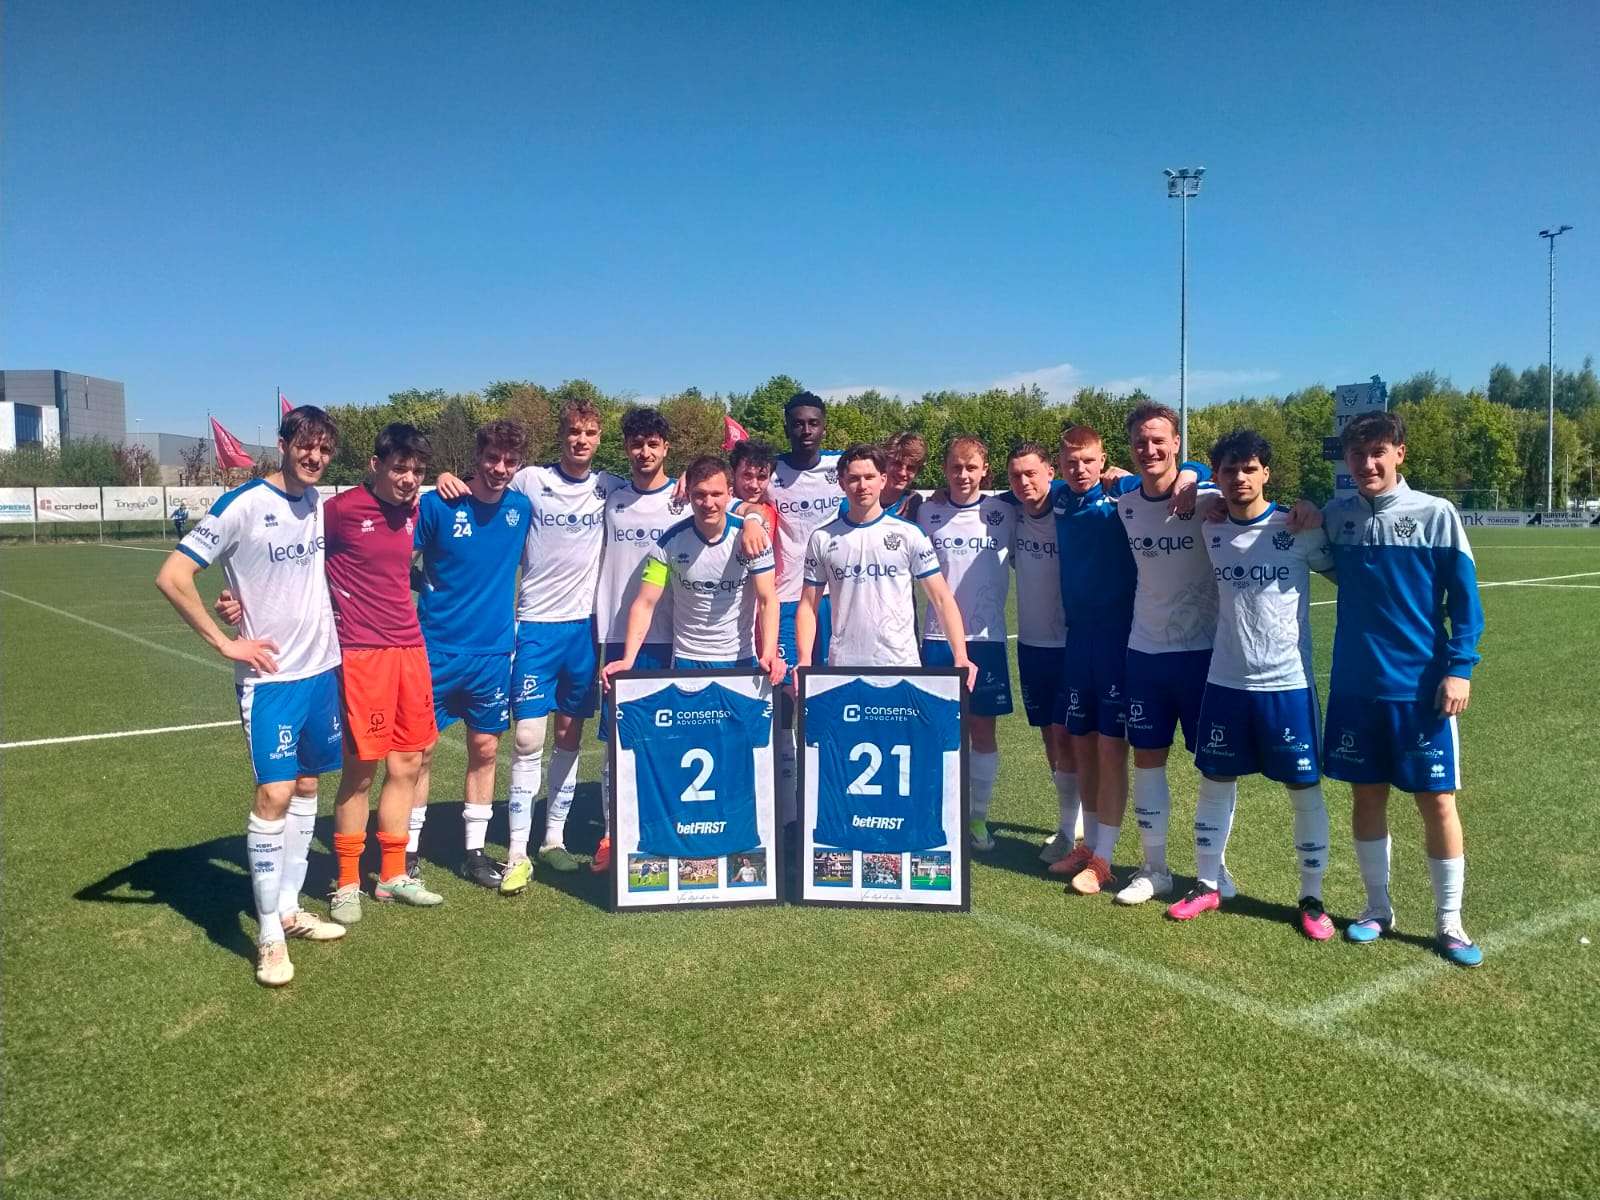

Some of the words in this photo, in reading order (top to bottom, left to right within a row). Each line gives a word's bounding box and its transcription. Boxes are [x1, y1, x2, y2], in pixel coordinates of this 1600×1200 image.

[775, 496, 840, 514] lecoque
[1460, 512, 1484, 526] nk
[453, 523, 472, 538] 24
[933, 536, 998, 552] ecoque
[1127, 535, 1194, 555] ecoque
[830, 563, 897, 581] lecoque
[1215, 565, 1290, 586] ecoque
[677, 710, 731, 720] consenso
[680, 748, 716, 802] 2
[846, 742, 912, 797] 21
[676, 821, 727, 835] betFIRST
[852, 814, 905, 830] betFIRST
